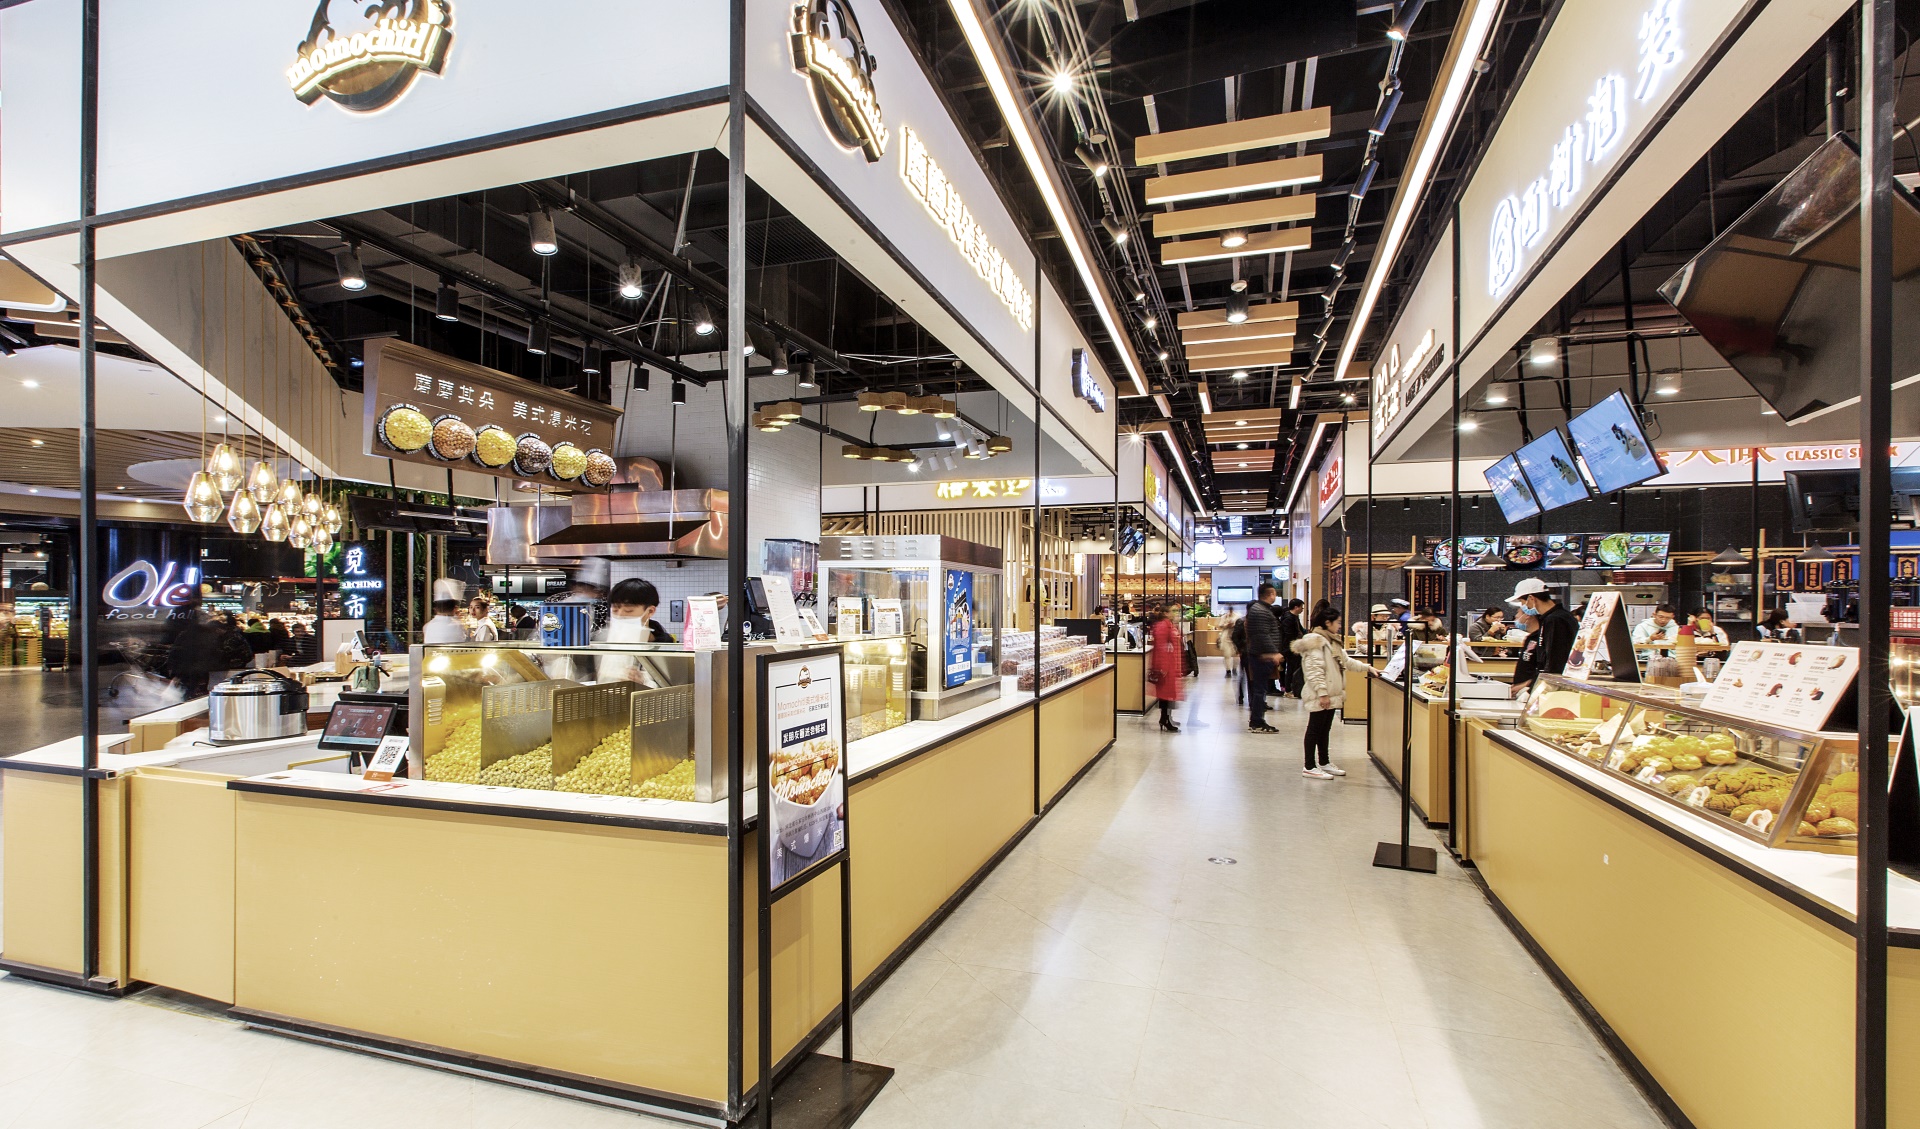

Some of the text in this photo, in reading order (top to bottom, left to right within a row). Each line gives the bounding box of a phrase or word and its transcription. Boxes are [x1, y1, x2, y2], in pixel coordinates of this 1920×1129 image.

[512, 400, 593, 436] 美式爆米花
[1785, 448, 1844, 461] CLASSIC
[105, 608, 158, 620] food
